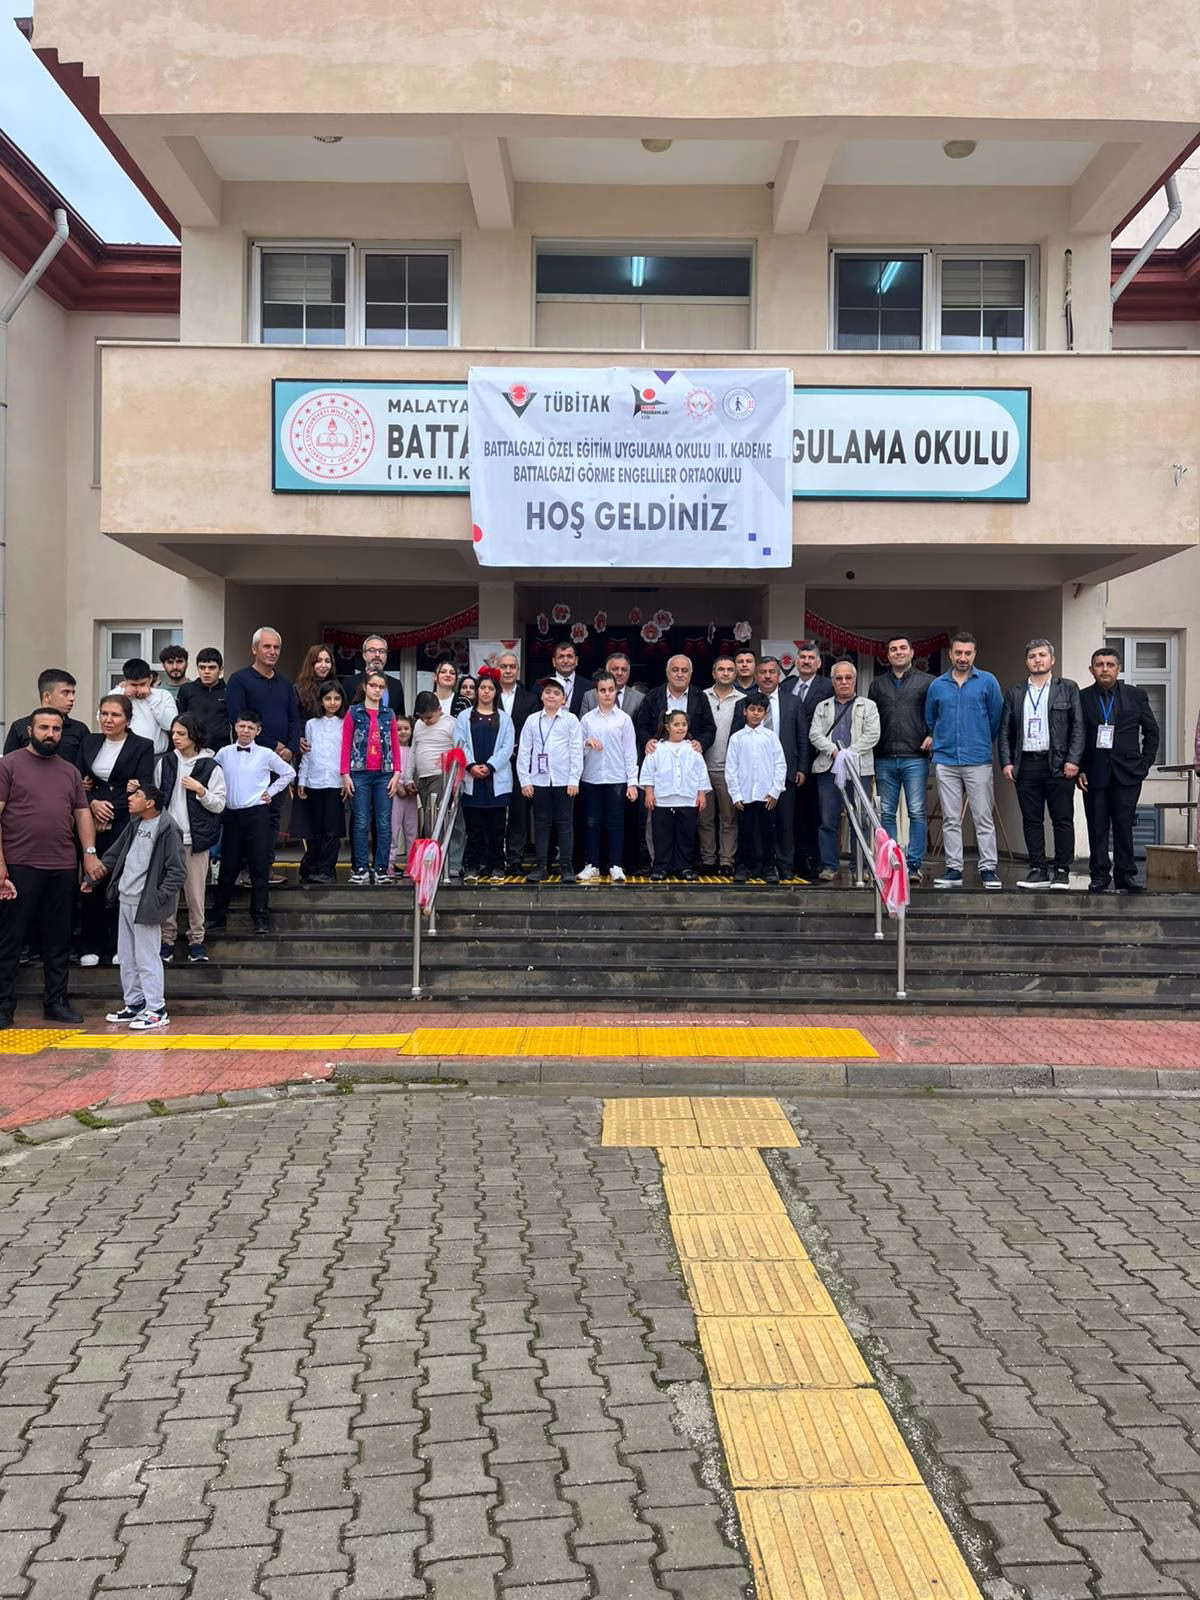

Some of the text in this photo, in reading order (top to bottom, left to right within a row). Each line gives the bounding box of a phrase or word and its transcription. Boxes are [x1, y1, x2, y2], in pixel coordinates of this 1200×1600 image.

[388, 399, 469, 413] MALATYA
[543, 391, 611, 412] TÜBİTAK
[483, 436, 772, 459] BATTALGAZİ ÖZEL EĞİTİM UYGULAMA OKULU II. KADEME
[914, 430, 1009, 465] OKULU
[412, 468, 433, 480] ve
[437, 465, 454, 480] II.
[513, 461, 742, 483] BATTALGAZİ GÖRME ENGELLİLER ORTAOKULU
[526, 493, 728, 538] HOŞ GELDİNİZ
